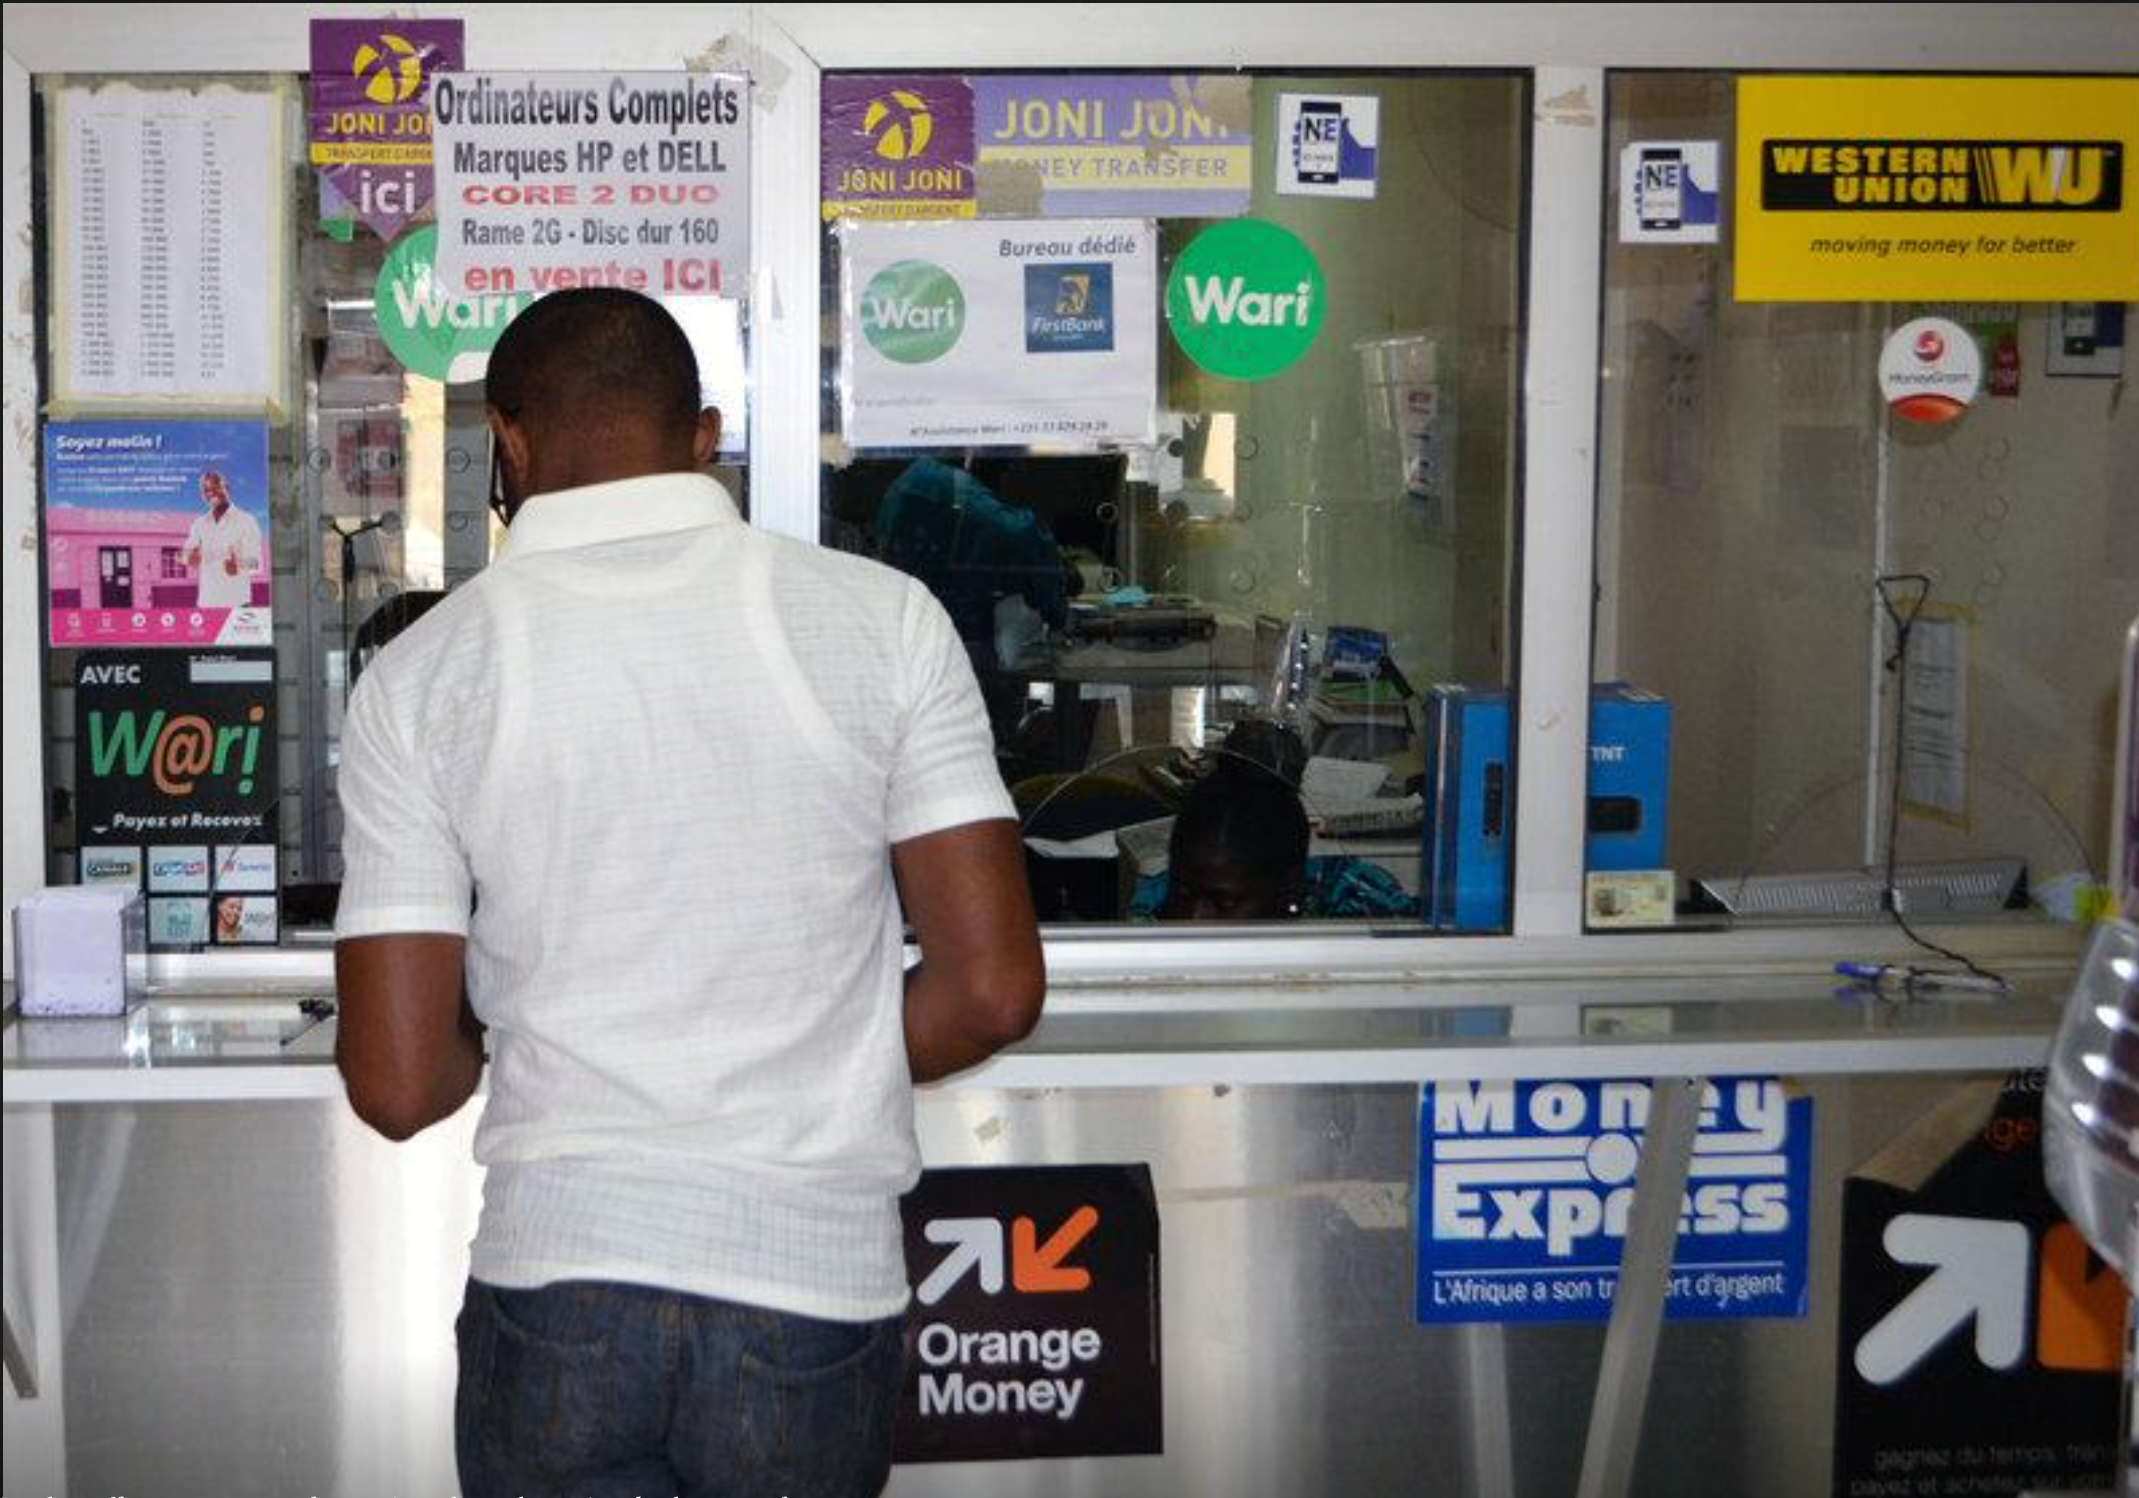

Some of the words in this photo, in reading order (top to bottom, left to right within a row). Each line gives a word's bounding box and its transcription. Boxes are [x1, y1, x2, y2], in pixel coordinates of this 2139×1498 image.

[435, 78, 598, 125] Ordinateurs
[609, 77, 738, 135] Complets
[327, 113, 384, 134] JONI
[994, 100, 1101, 139] JONI
[1120, 100, 1229, 139] JON
[1304, 116, 1338, 141] NE
[454, 142, 567, 181] Marques
[577, 142, 613, 172] HP
[623, 143, 648, 172] et
[659, 141, 726, 172] DELL
[1093, 157, 1228, 177] TRANSFER
[838, 169, 895, 192] JONI
[903, 168, 962, 192] JONI
[1645, 163, 1679, 189] NE
[1773, 146, 1971, 174] WESTERN
[1991, 146, 2104, 204] WU
[361, 170, 415, 213] ici
[462, 185, 577, 205] CORE
[591, 185, 616, 205] 2
[630, 185, 719, 205] DUO
[1834, 177, 1969, 203] UNION
[463, 219, 524, 245] Rame
[532, 219, 561, 245] 2G
[583, 218, 630, 245] Disc
[638, 218, 672, 245] dur
[679, 218, 718, 245] 160
[999, 240, 1072, 257] Bureau
[1078, 236, 1136, 255] dédié
[1810, 238, 1891, 256] moving
[1897, 238, 1969, 256] money
[1976, 235, 2005, 253] for
[2012, 235, 2077, 254] better
[464, 265, 515, 290] en
[530, 261, 648, 290] vente
[663, 259, 721, 291] ICI
[873, 298, 955, 330] Wari
[1184, 276, 1312, 326] Wari
[1031, 317, 1106, 335] FirstBank
[56, 434, 102, 452] Soyez
[80, 665, 141, 684] AVEC
[1591, 746, 1626, 762] TNT
[113, 812, 166, 831] Payez
[171, 813, 187, 828] et
[191, 812, 262, 828] Recevez
[1432, 1168, 1790, 1256] Exprss
[1434, 1278, 1527, 1307] L'Afrique
[1532, 1284, 1547, 1300] a
[1553, 1280, 1592, 1301] son
[1694, 1272, 1783, 1308] d'argent
[918, 1322, 1101, 1371] Orange
[918, 1372, 1084, 1420] Money
